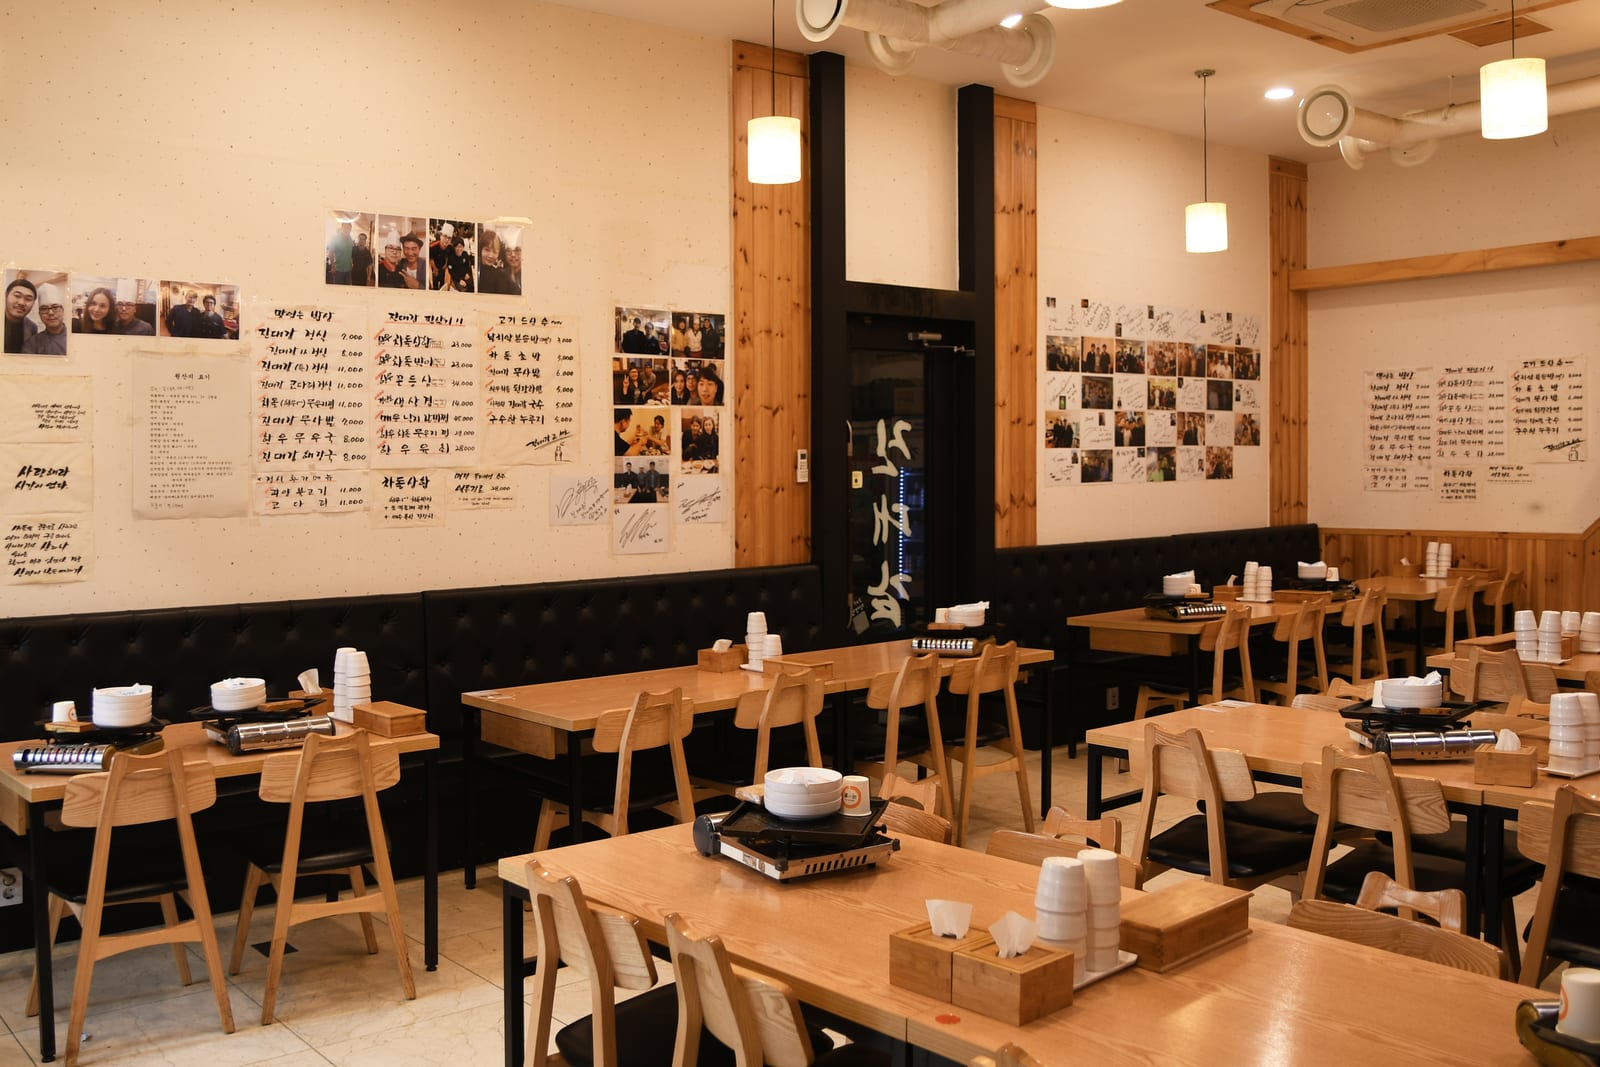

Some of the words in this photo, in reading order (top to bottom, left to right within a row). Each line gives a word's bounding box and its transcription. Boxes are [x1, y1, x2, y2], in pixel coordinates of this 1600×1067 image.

[388, 312, 418, 323] 진대감
[258, 328, 295, 339] 진대감
[305, 329, 326, 342] 정식
[270, 346, 297, 355] 진대감
[262, 361, 292, 372] 진대감
[262, 416, 296, 426] 진대감
[263, 450, 298, 462] 진대감
[17, 465, 70, 477] 사랑해라
